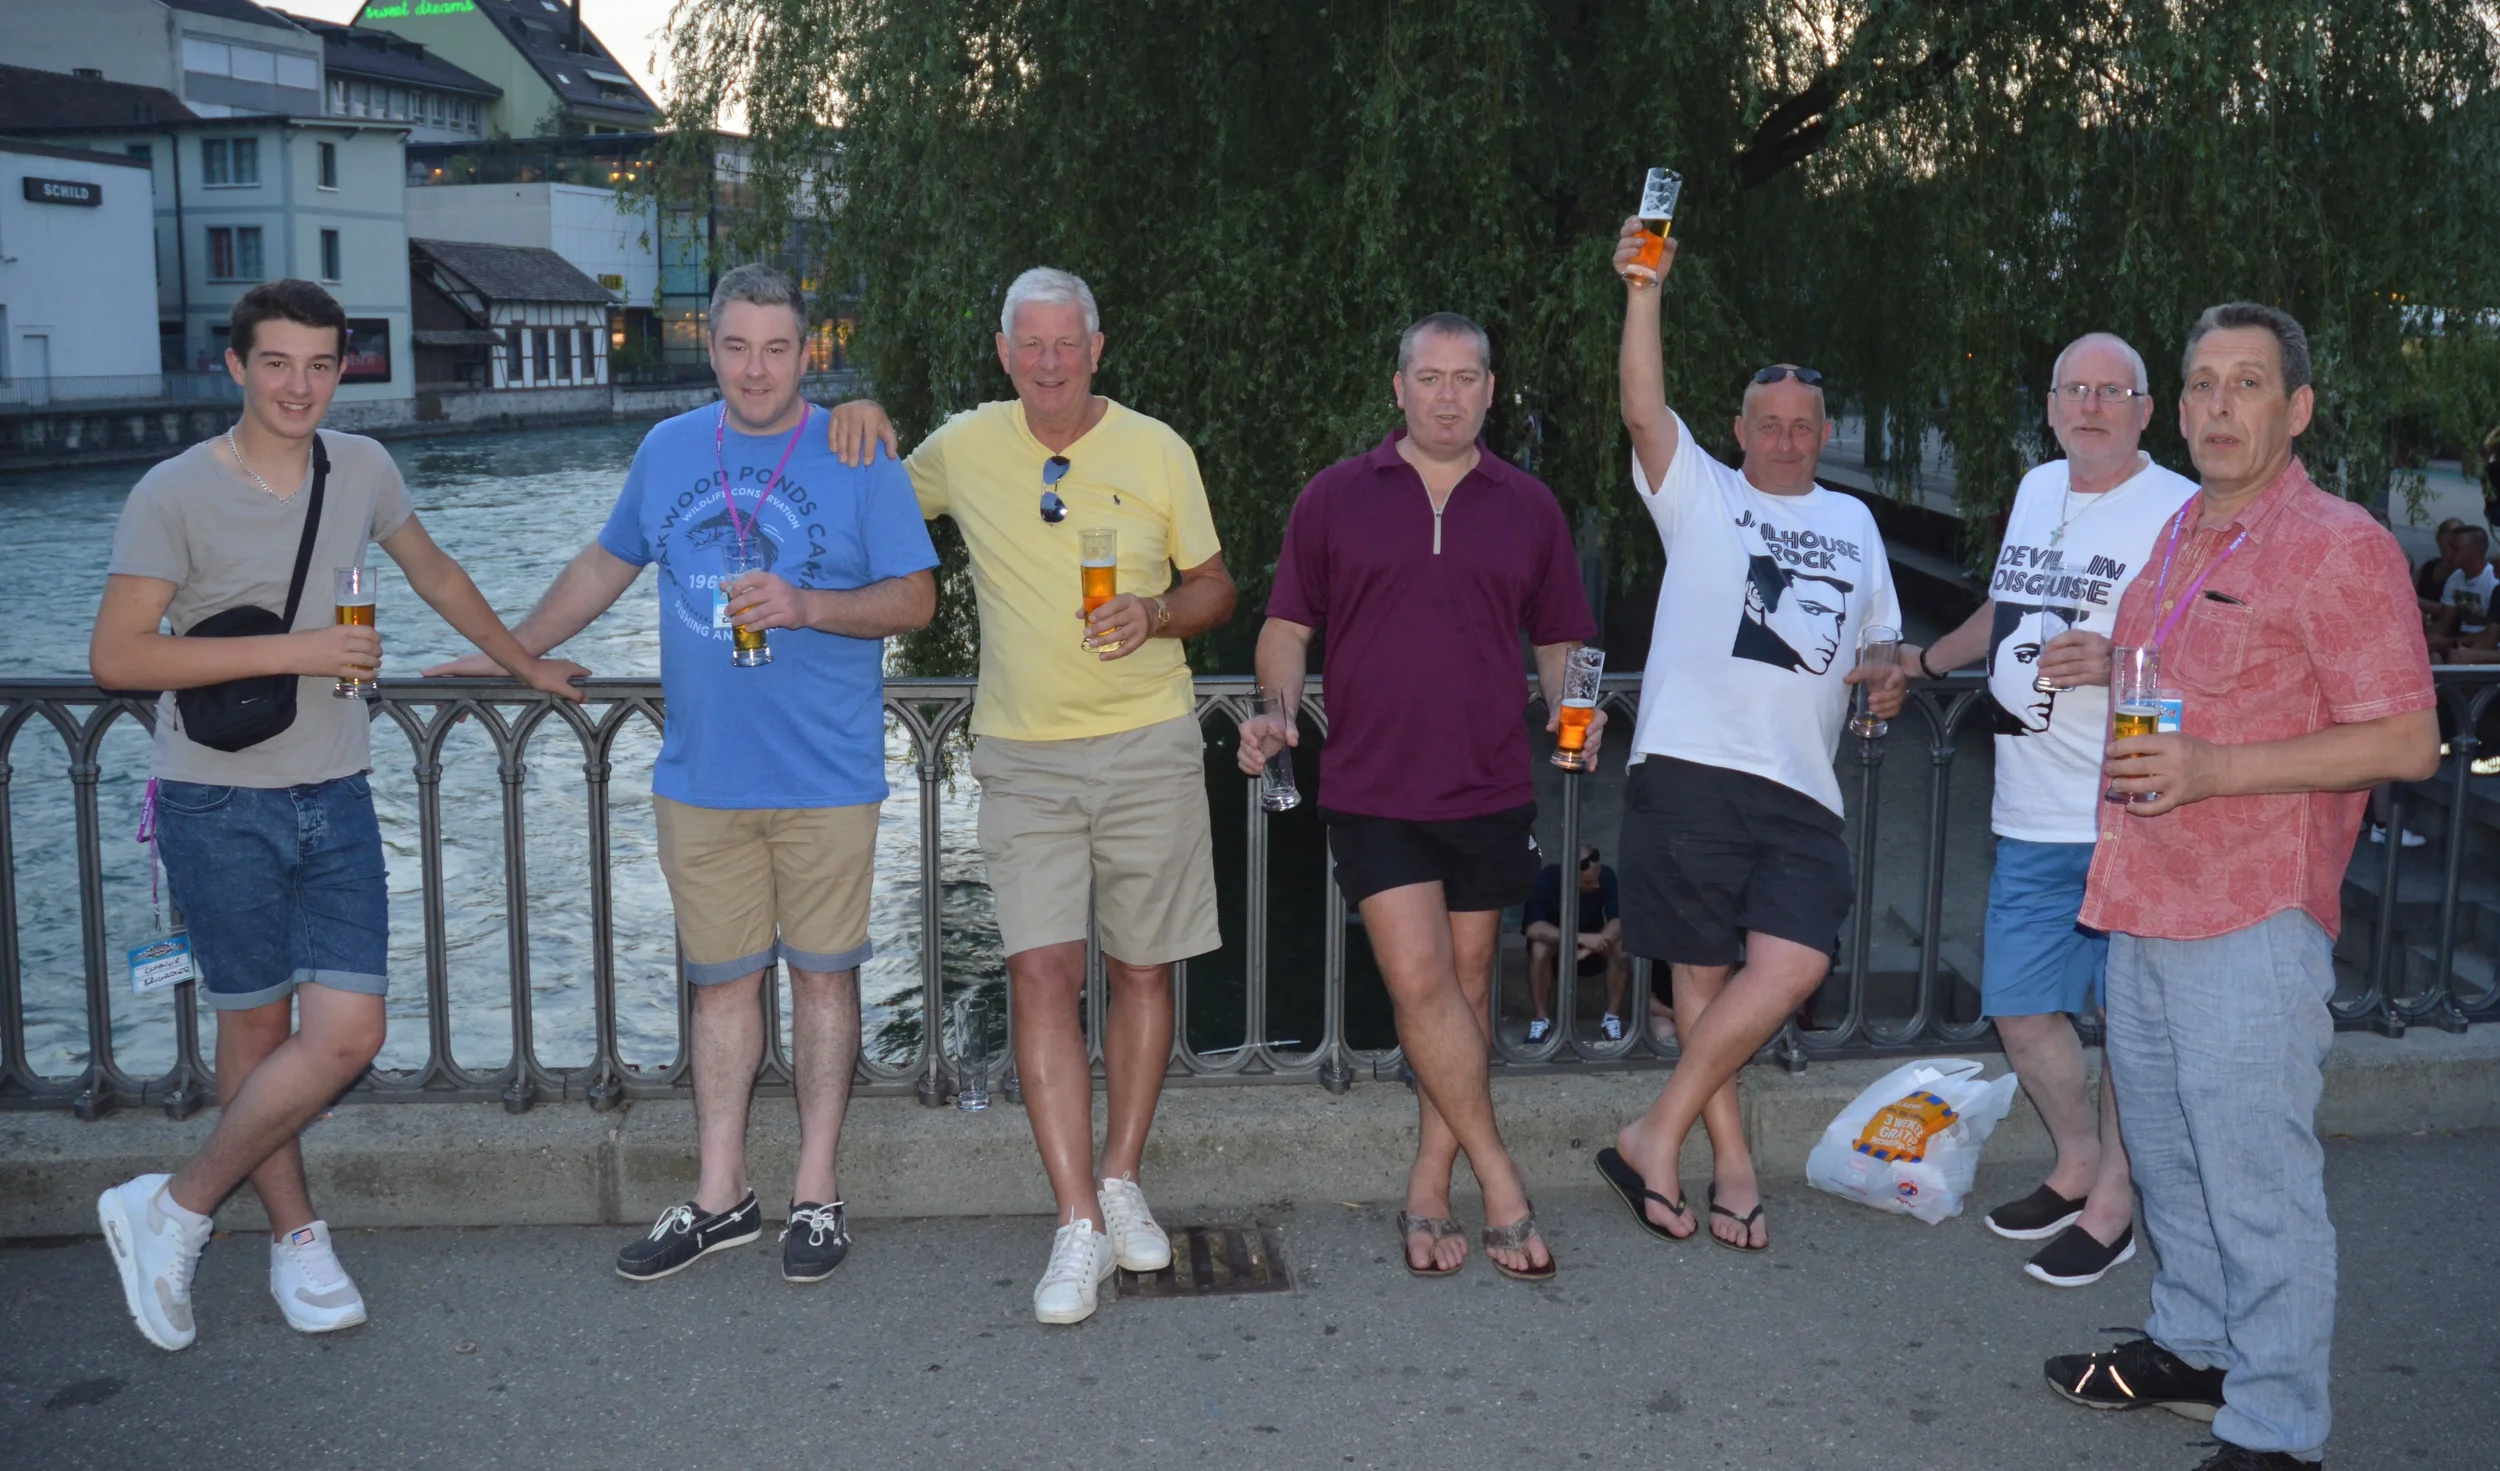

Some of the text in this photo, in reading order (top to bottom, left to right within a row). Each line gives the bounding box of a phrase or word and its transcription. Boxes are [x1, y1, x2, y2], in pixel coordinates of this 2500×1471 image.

[366, 0, 476, 19] sweet dreams
[43, 183, 90, 200] SCHILD
[682, 488, 801, 530] WILDLIFE CONSRVATION
[738, 466, 818, 517] PONDS
[1735, 509, 1862, 563] JILHOUSE
[1766, 542, 1837, 572] ROCK
[2086, 554, 2127, 580] IN
[1994, 569, 2113, 606] DISGUISE
[674, 599, 733, 641] FISHING AN
